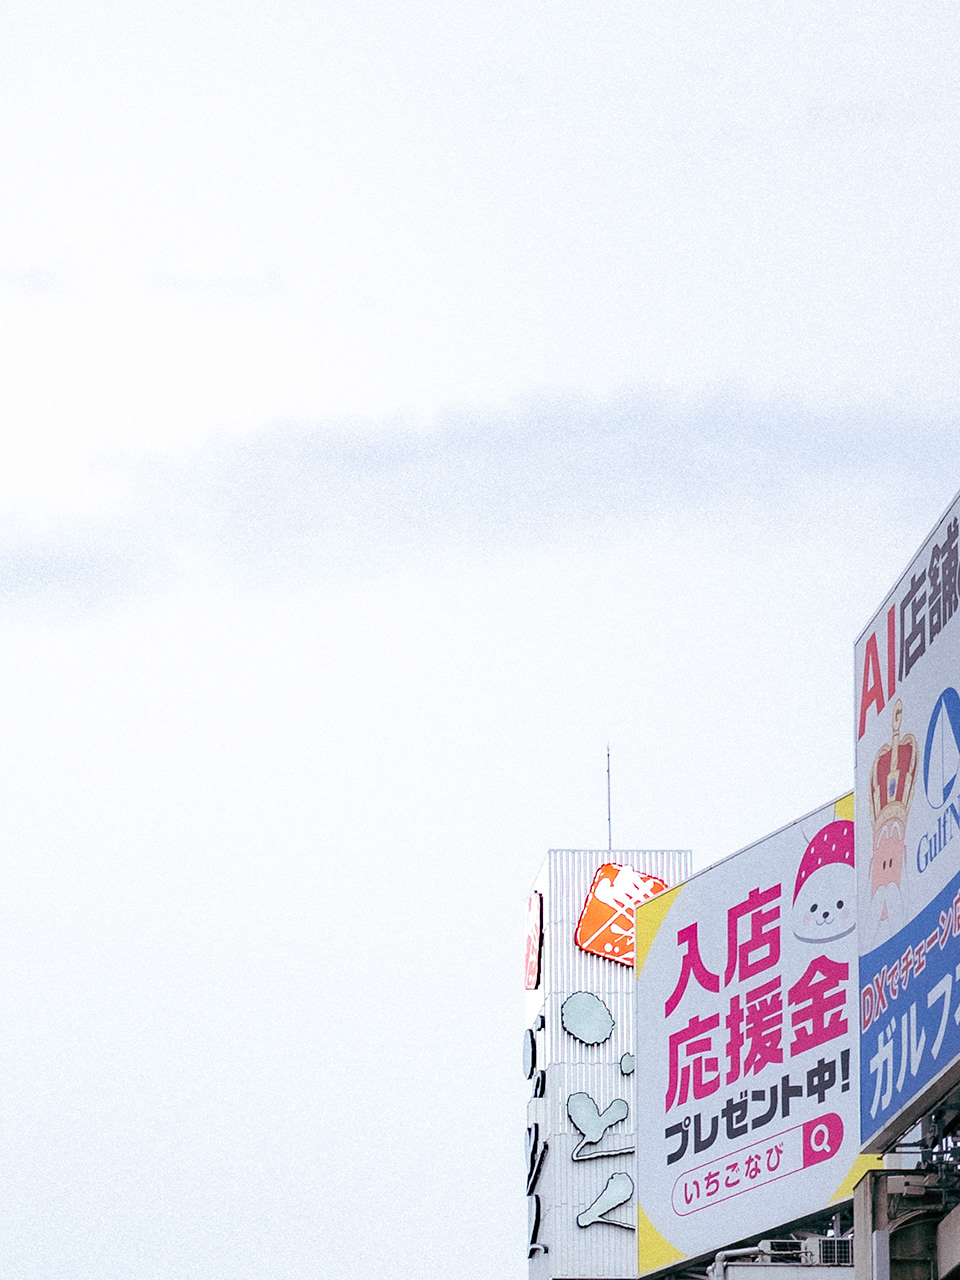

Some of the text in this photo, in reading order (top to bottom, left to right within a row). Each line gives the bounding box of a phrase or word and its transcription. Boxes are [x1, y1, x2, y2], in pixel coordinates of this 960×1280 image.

[858, 517, 960, 741] AI店舗
[665, 882, 781, 1018] 入店
[665, 955, 848, 1112] 応援金
[869, 964, 960, 1119] ガルフ
[665, 1049, 850, 1164] プレゼント中!
[684, 1142, 783, 1203] いちごなび
